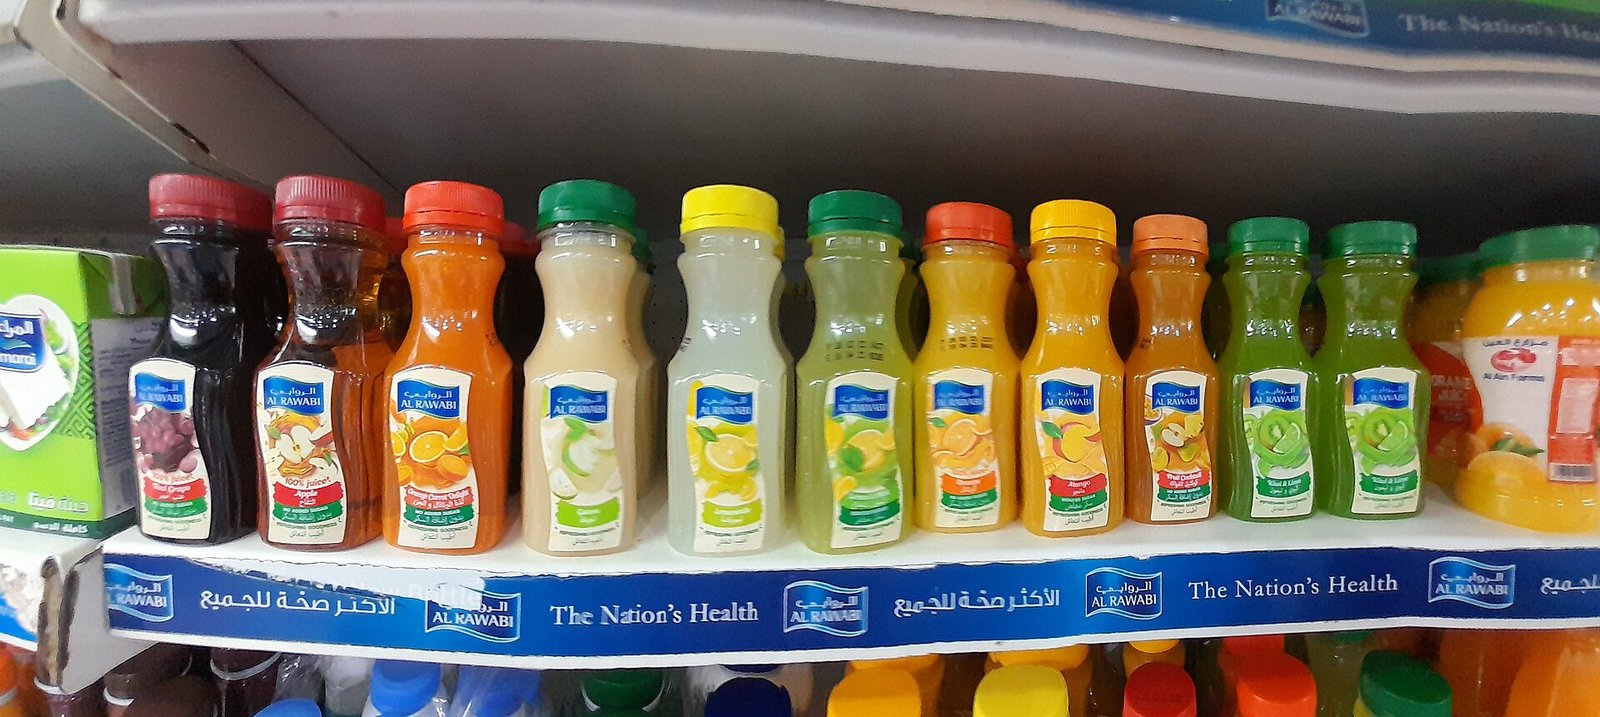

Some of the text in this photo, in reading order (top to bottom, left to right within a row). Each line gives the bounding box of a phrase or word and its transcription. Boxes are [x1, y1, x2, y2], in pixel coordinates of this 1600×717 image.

[404, 390, 452, 399] الروابي
[1266, 395, 1299, 403] RAWABI
[267, 397, 320, 406] AL RAWABI
[401, 400, 456, 409] AL RAWABI
[1058, 398, 1092, 406] RAWABI
[1155, 397, 1198, 406] AL RAWABI
[553, 405, 567, 414] AL
[294, 490, 318, 499] Apple
[1096, 581, 1152, 594] الروابي
[1188, 573, 1398, 600] The Nation's Health
[1435, 584, 1508, 595] AL RAWABI
[1541, 573, 1600, 594] لجميع
[116, 593, 167, 607] RAWABI
[201, 590, 271, 613] للجميع
[893, 593, 956, 617] للجميع
[1007, 587, 1060, 612] الأكثر
[1091, 594, 1157, 608] AL RAWABI
[550, 601, 759, 625] The Nation's Health
[790, 609, 862, 623] AL RAWABI
[432, 612, 514, 628] AL RAWABI
